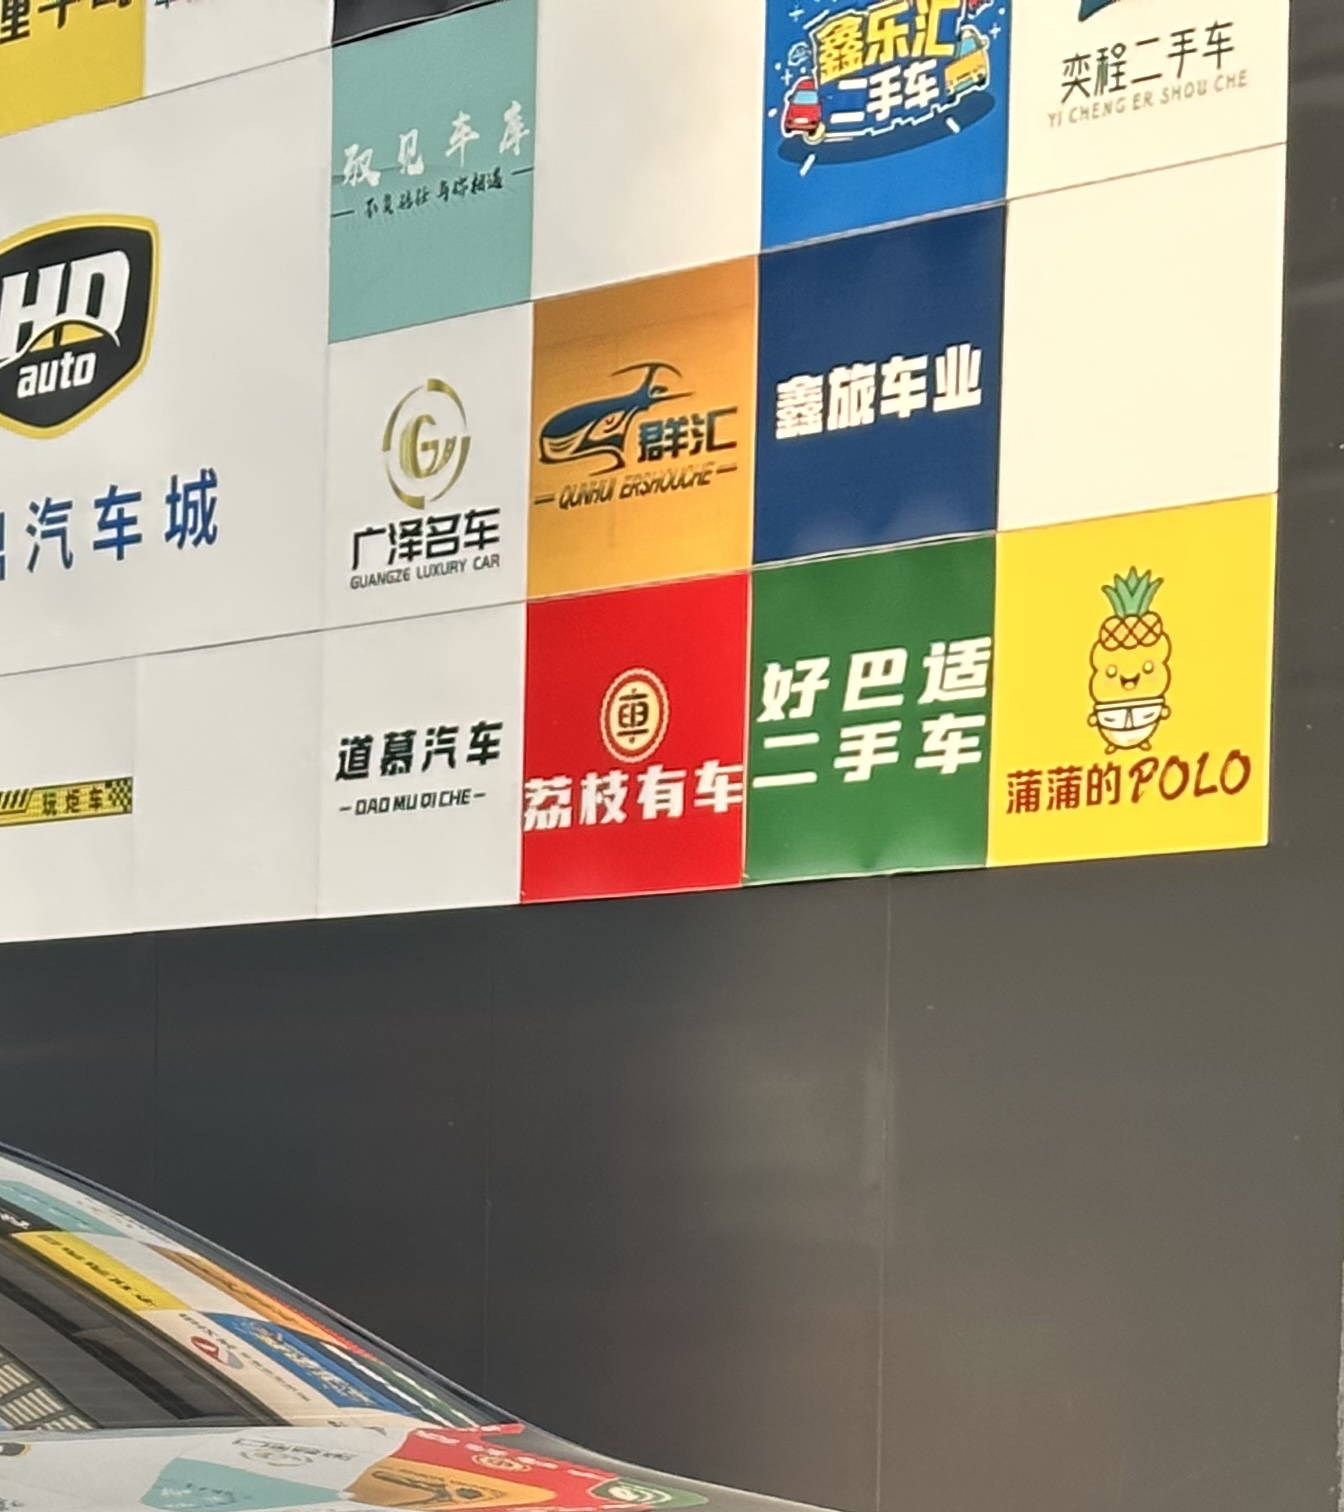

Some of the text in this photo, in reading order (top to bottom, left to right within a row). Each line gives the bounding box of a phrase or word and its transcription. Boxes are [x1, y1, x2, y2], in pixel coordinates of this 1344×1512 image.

[816, 0, 960, 84] 鑫乐汇
[1061, 20, 1235, 104] 奕程二手车
[830, 60, 939, 122] 二手车
[1047, 68, 1248, 128] YI CHENG ER SHOU CHE
[16, 350, 96, 399] auto
[637, 406, 737, 463] 群汇
[351, 507, 501, 571] 广泽名车
[416, 558, 467, 580] LUXURY
[472, 553, 500, 571] CAR
[757, 637, 993, 723] 好巴适
[335, 720, 503, 783] 道慕汽车
[752, 712, 987, 789] 二手车
[438, 788, 471, 808] CHE
[524, 759, 743, 832] 荔枝有车
